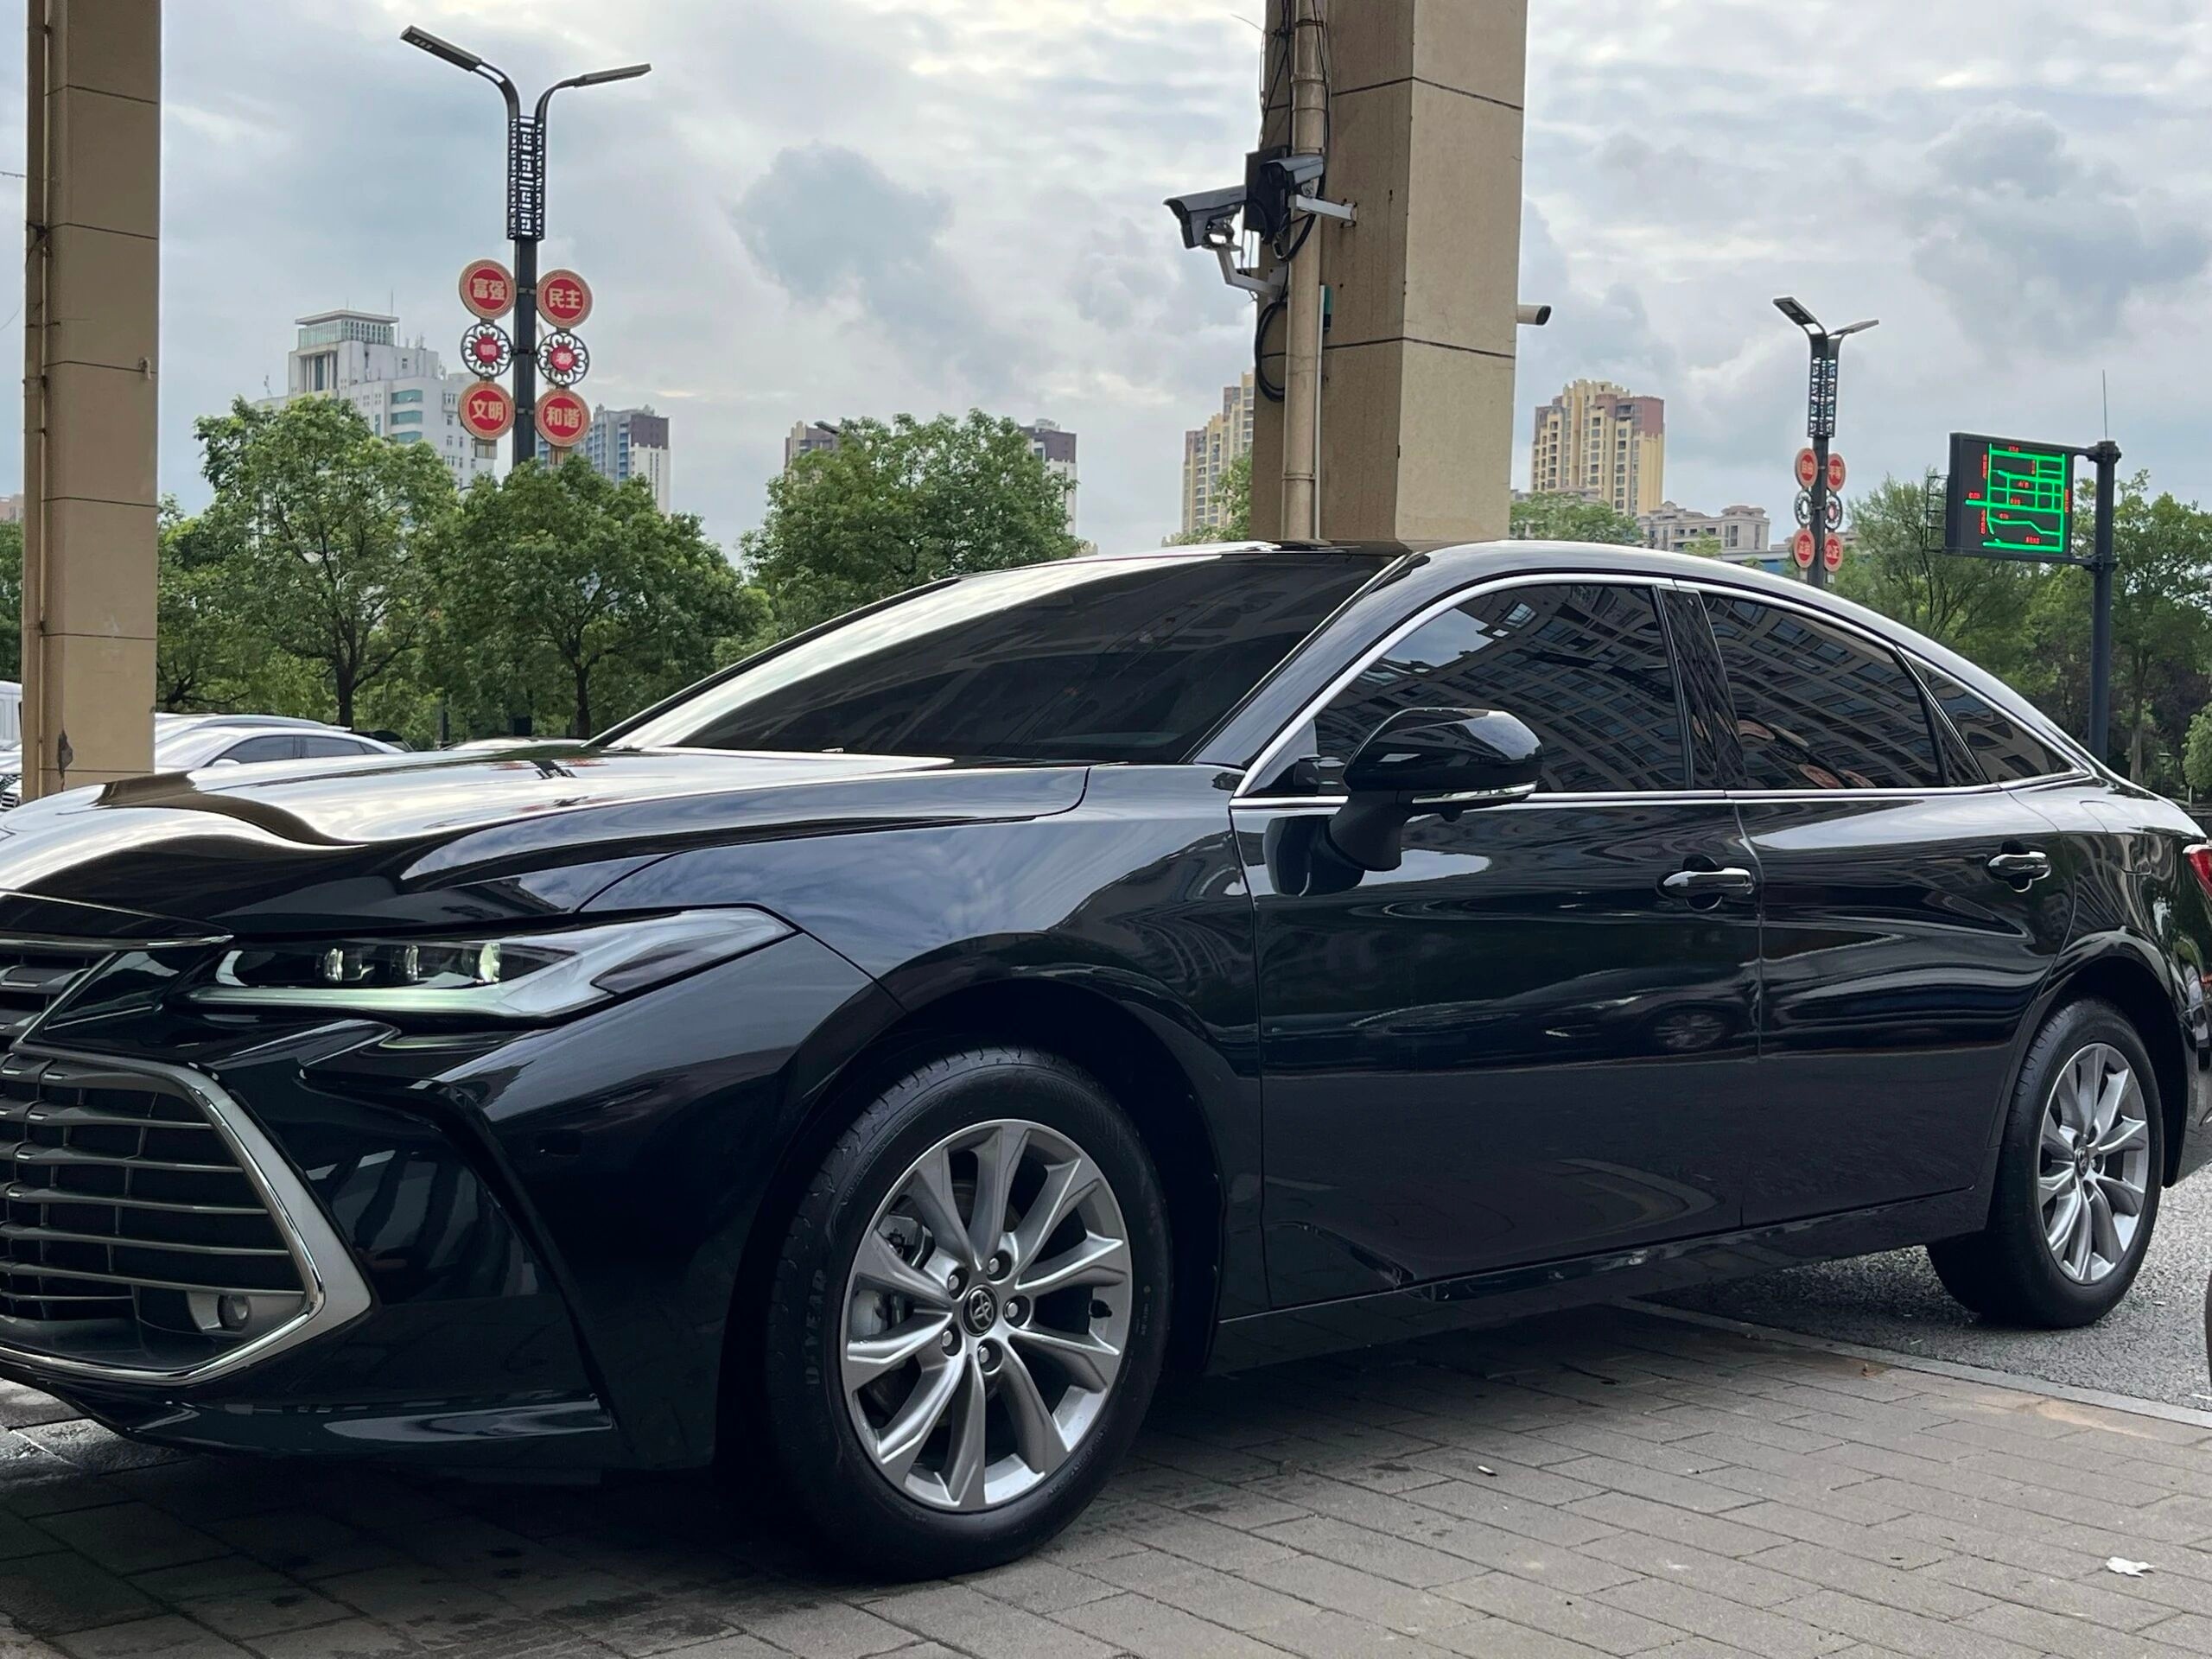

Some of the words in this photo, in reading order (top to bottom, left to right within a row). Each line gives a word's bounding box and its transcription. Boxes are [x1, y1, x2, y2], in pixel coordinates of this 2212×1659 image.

[473, 278, 505, 301] 富强
[549, 288, 581, 310] 民主
[473, 400, 504, 422] 文明
[546, 407, 580, 429] 和谐
